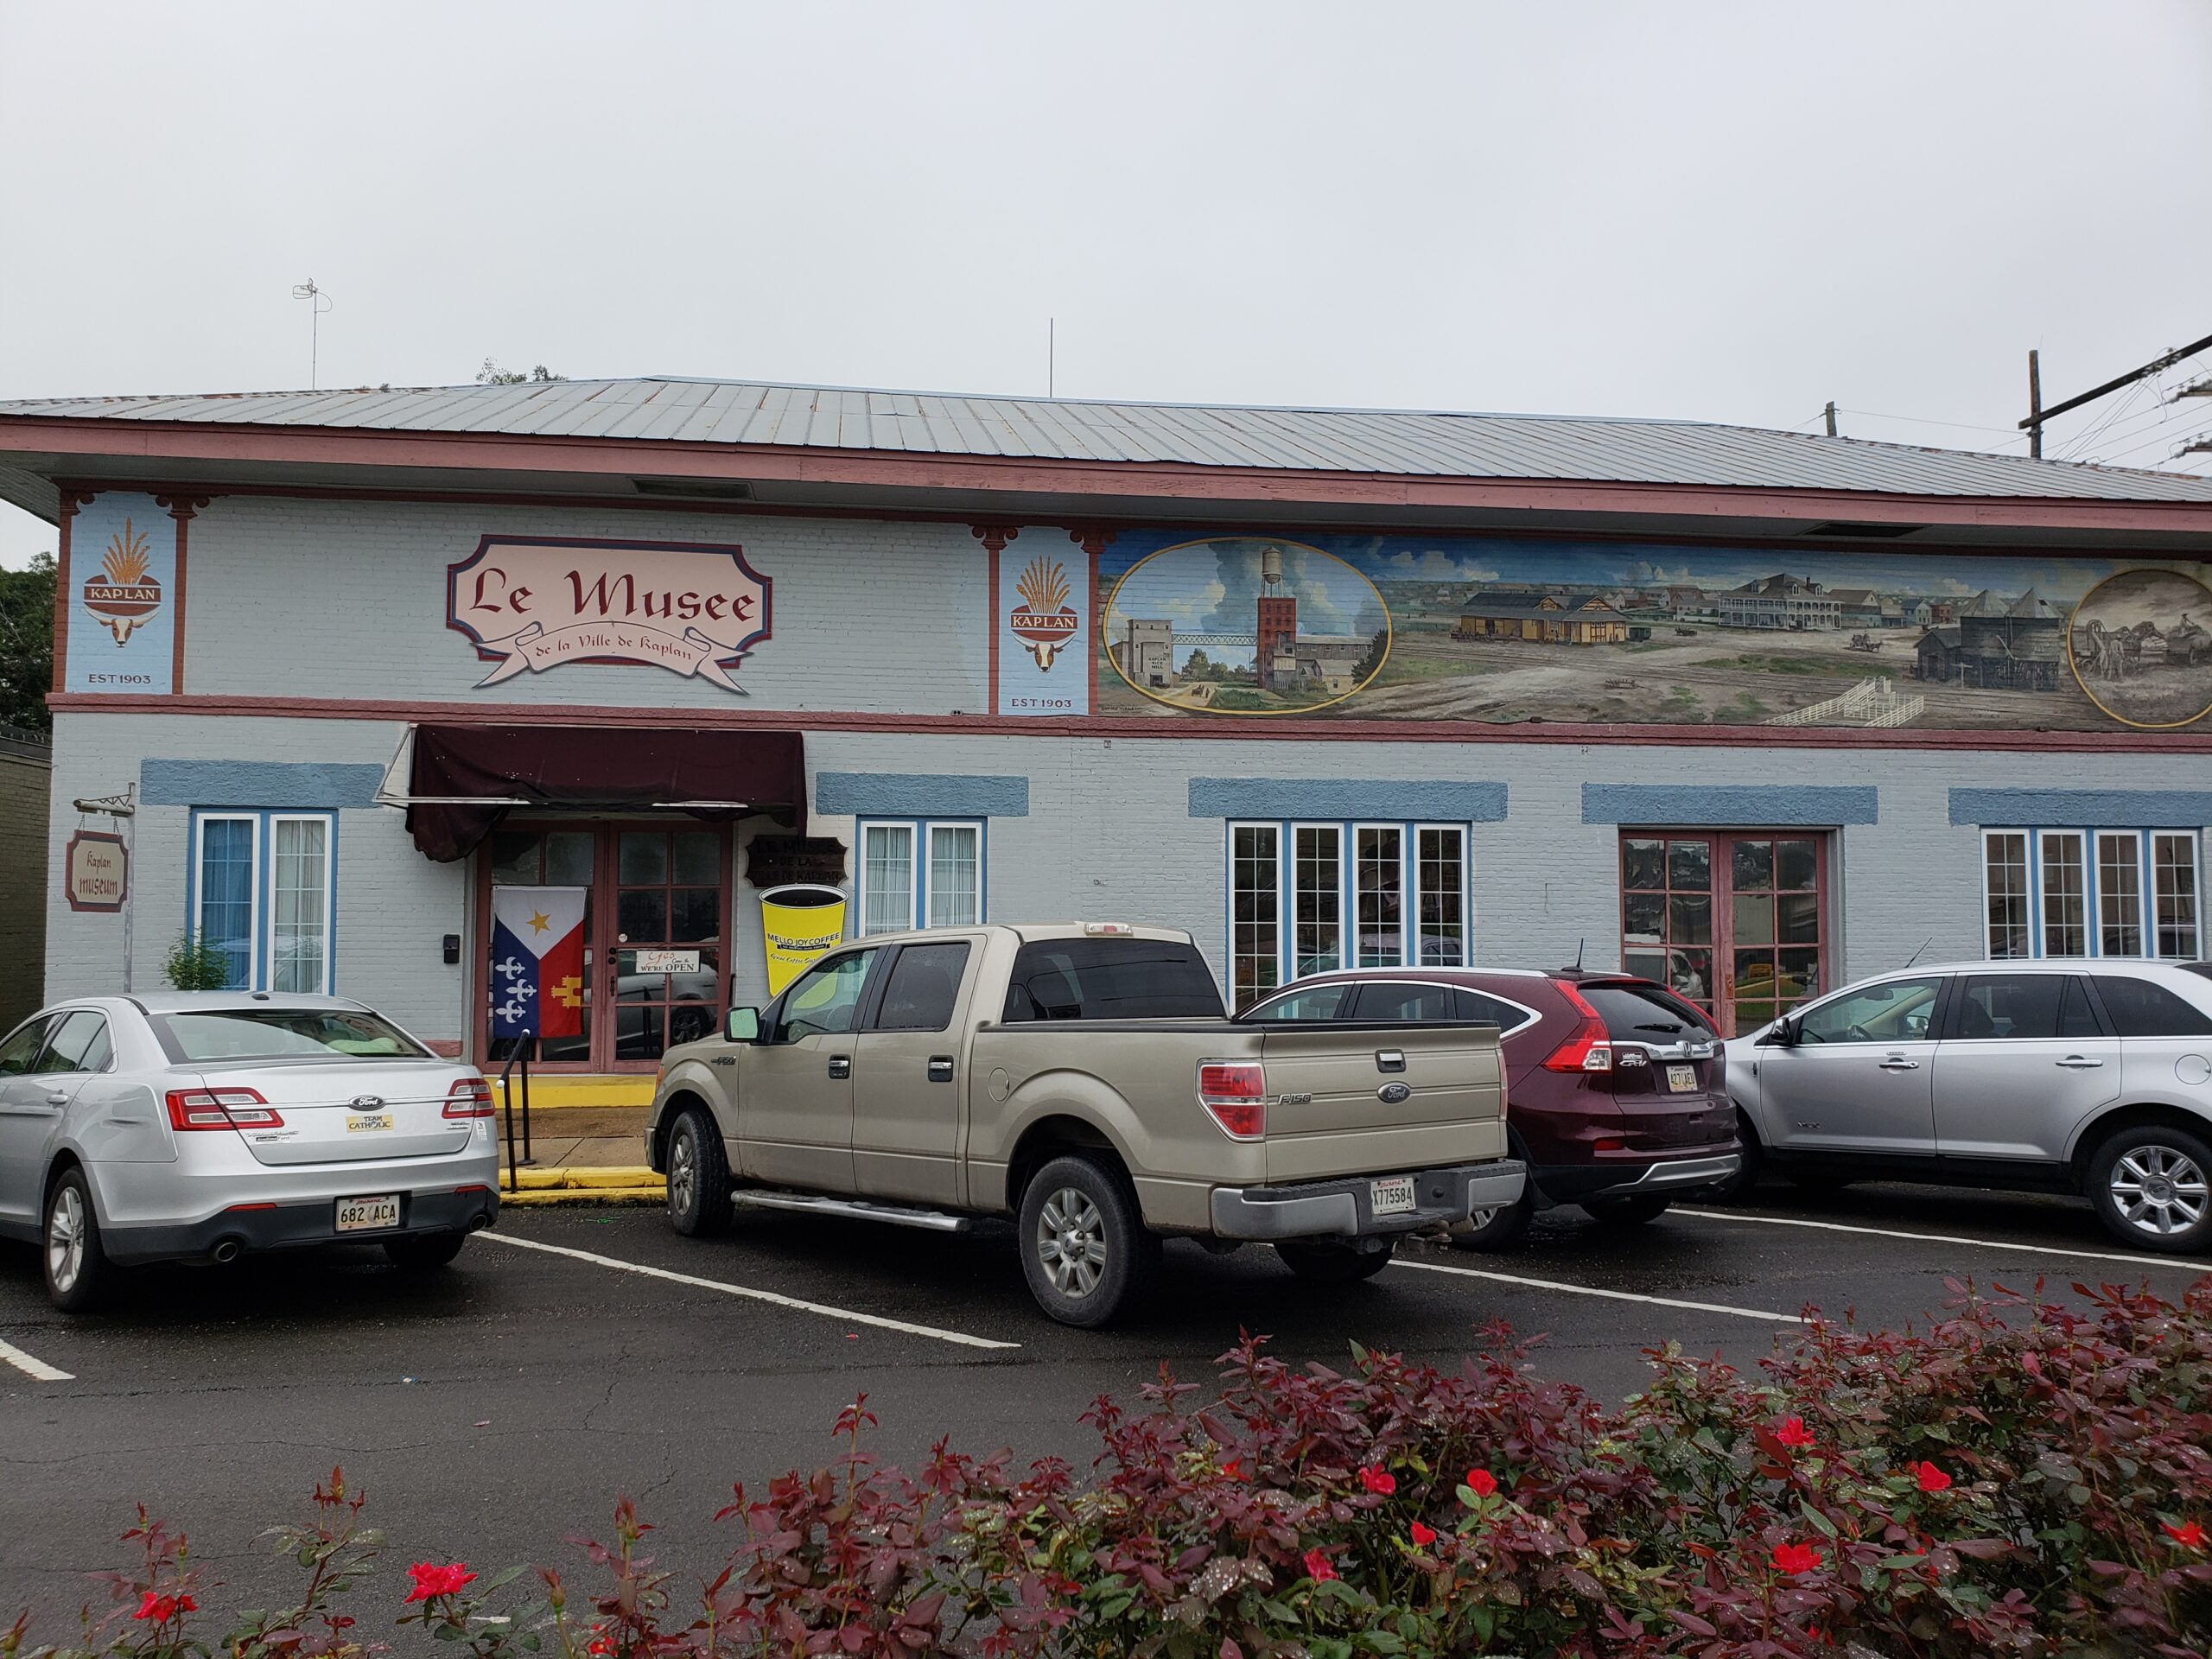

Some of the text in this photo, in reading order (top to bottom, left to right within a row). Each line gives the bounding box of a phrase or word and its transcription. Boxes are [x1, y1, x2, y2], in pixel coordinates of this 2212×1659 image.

[91, 588, 155, 600] KAPLAN
[469, 568, 756, 622] Le Musee
[1013, 616, 1074, 628] KAPLAN
[536, 635, 692, 661] de la Ville de Kaplan
[88, 673, 151, 684] EST 1903
[1011, 698, 1071, 708] EST 1903
[87, 850, 111, 874] Kaplan
[79, 878, 118, 896] museum
[767, 933, 793, 945] MELLO
[809, 932, 840, 945] COFFEE
[1278, 1093, 1313, 1105] F-150
[1387, 1086, 1406, 1099] Ford
[358, 1097, 378, 1106] Ford
[349, 1121, 391, 1129] CATHOLIC
[1373, 1186, 1413, 1205] X775584
[340, 1204, 396, 1224] 682 ACA
